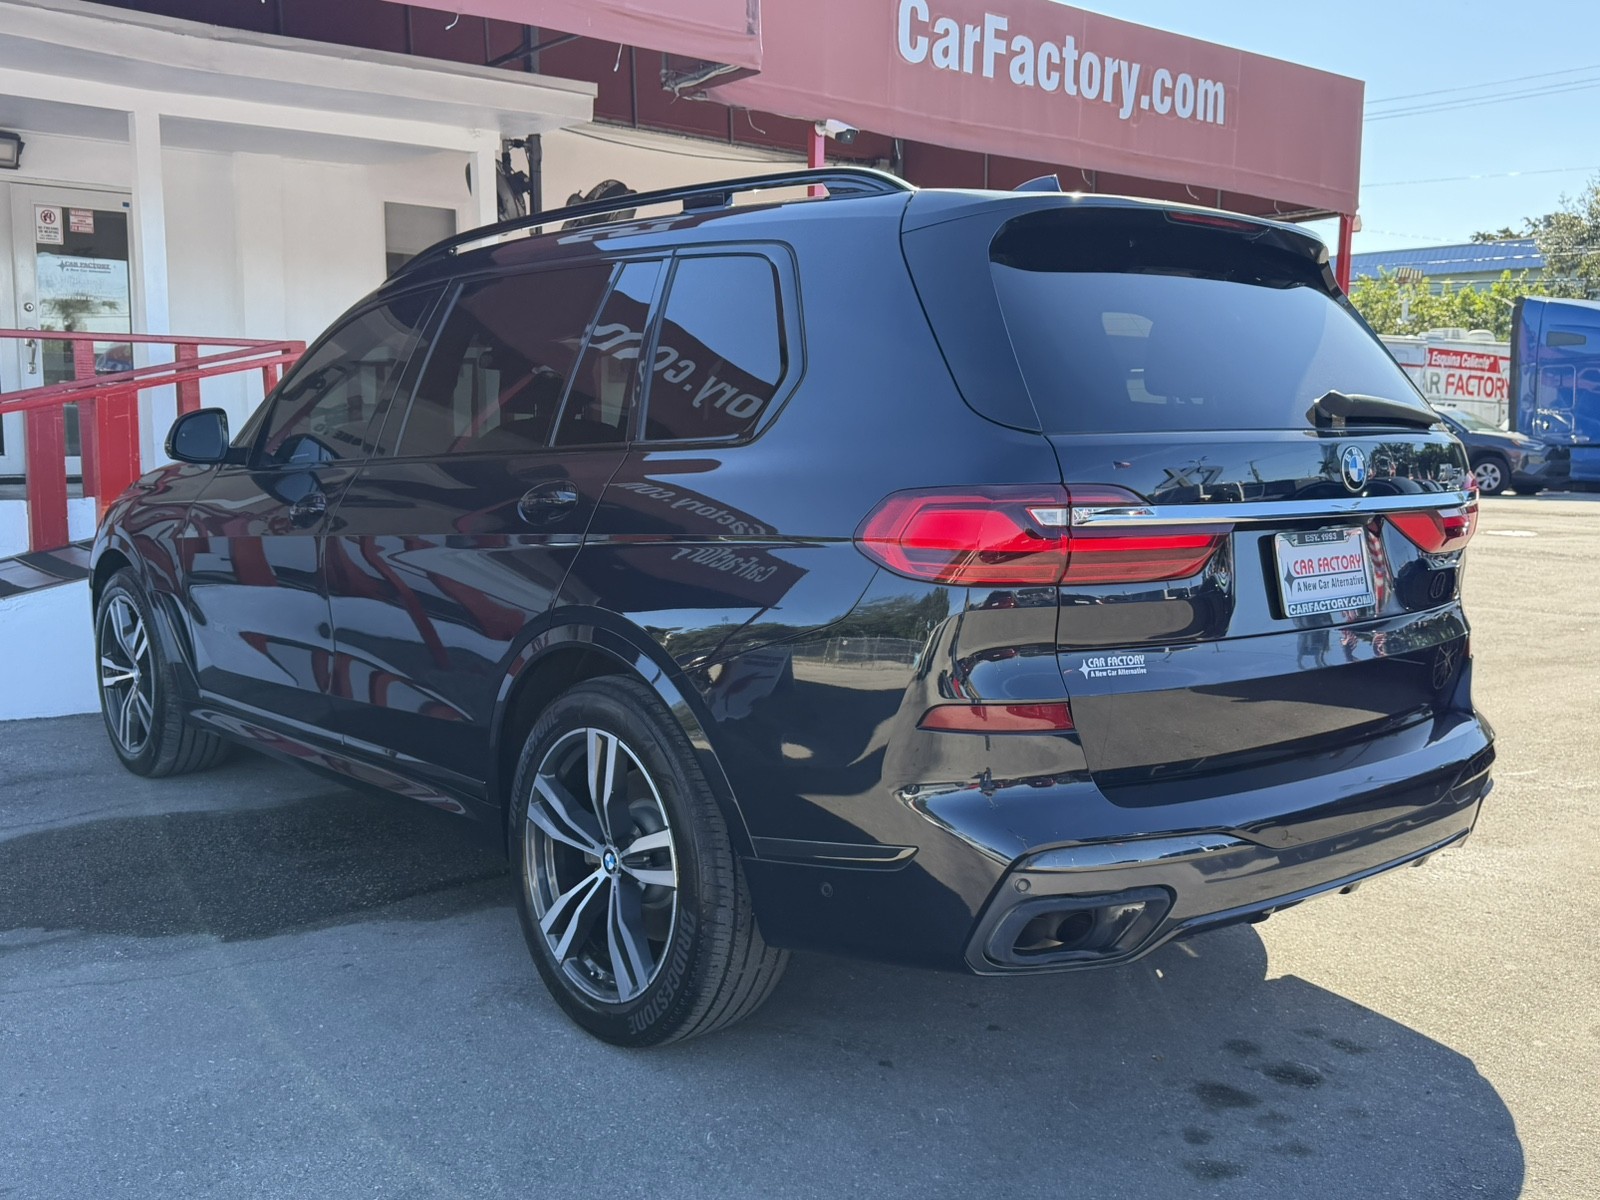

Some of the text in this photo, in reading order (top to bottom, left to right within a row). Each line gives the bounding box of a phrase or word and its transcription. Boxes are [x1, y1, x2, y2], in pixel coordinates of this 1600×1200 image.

[898, 0, 1225, 125] CarFactory.com
[1431, 351, 1460, 369] Esquina
[1156, 466, 1223, 488] X7
[1304, 532, 1338, 543] EST. 1993
[1293, 553, 1361, 575] CAR FACTORY
[1297, 575, 1365, 592] A New Car Alternative
[1290, 595, 1371, 614] CARFACTORY.COM
[1088, 654, 1144, 667] CAR FACTORY
[1118, 667, 1147, 676] Alternative
[627, 905, 697, 1035] BRIDGESTONE
